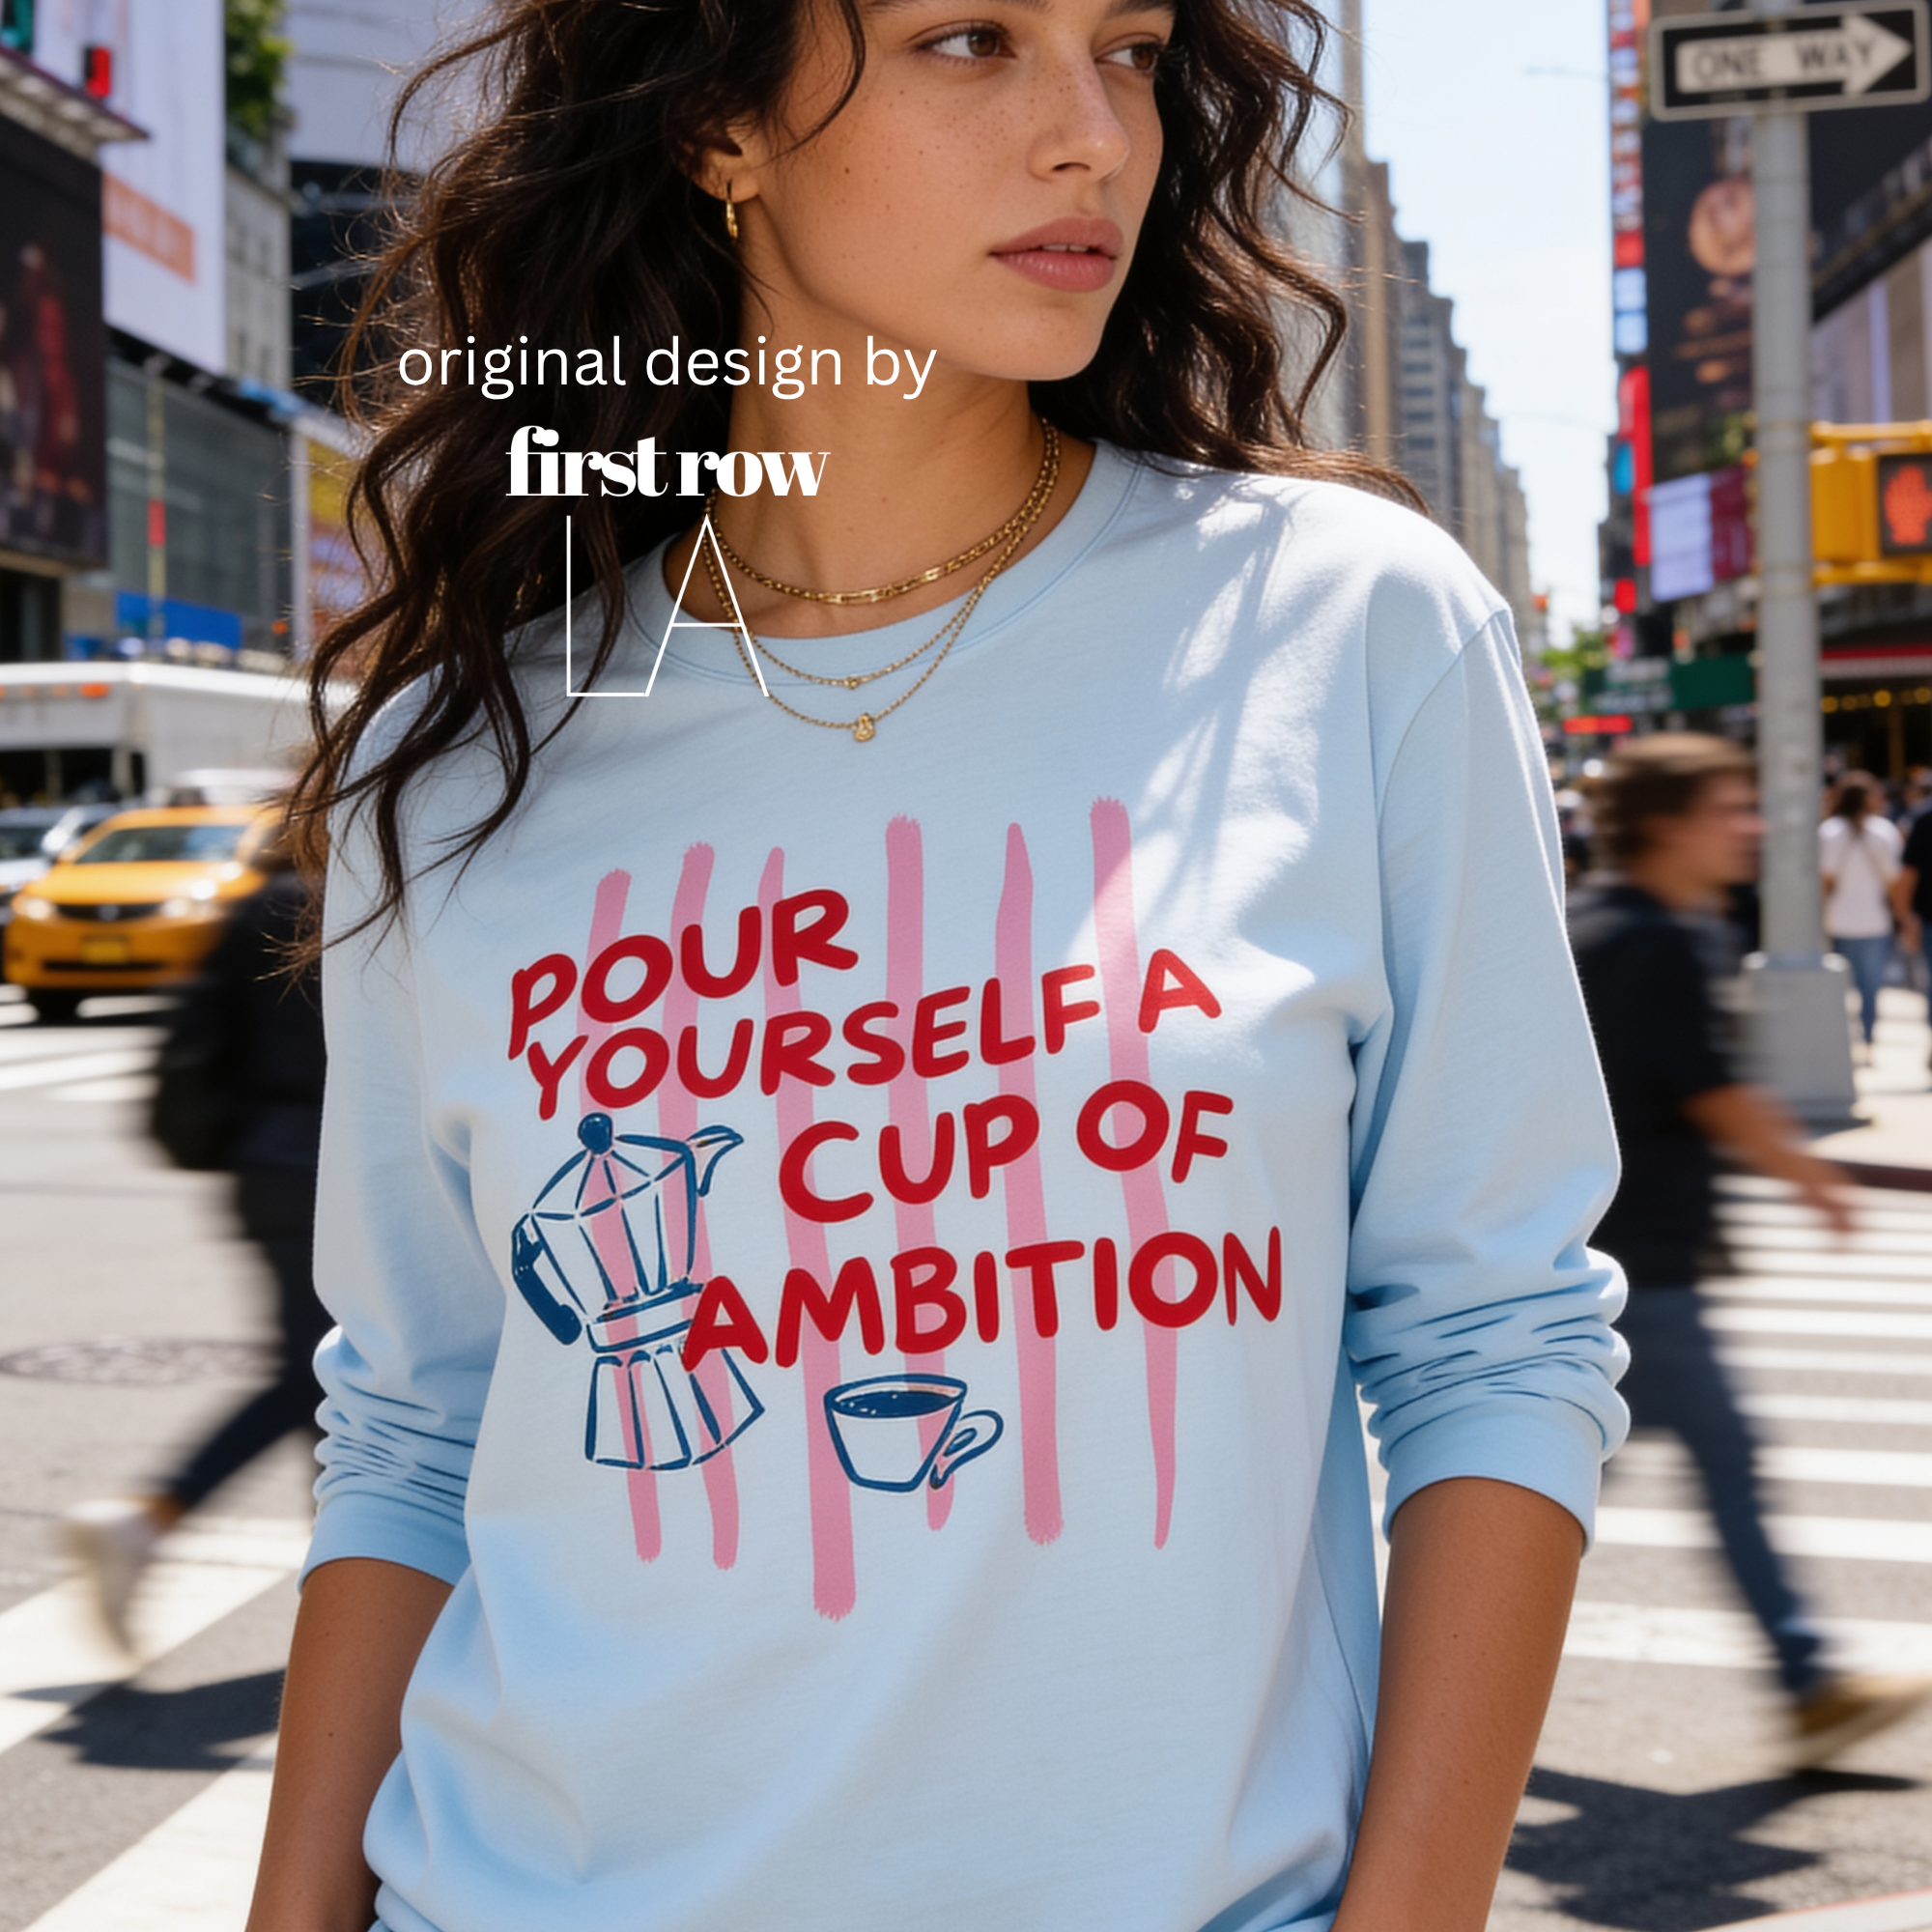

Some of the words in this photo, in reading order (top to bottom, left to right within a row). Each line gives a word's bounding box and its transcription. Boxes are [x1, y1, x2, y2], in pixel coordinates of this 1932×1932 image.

[1692, 47, 1761, 82] ONE
[1794, 37, 1874, 72] WAY
[508, 889, 859, 1061] POUR
[527, 963, 1101, 1121] YOURSELF
[1138, 949, 1222, 1034] A
[779, 1094, 1041, 1224] CUP
[1076, 1079, 1235, 1184] OF
[680, 1226, 1283, 1373] AMBITION
